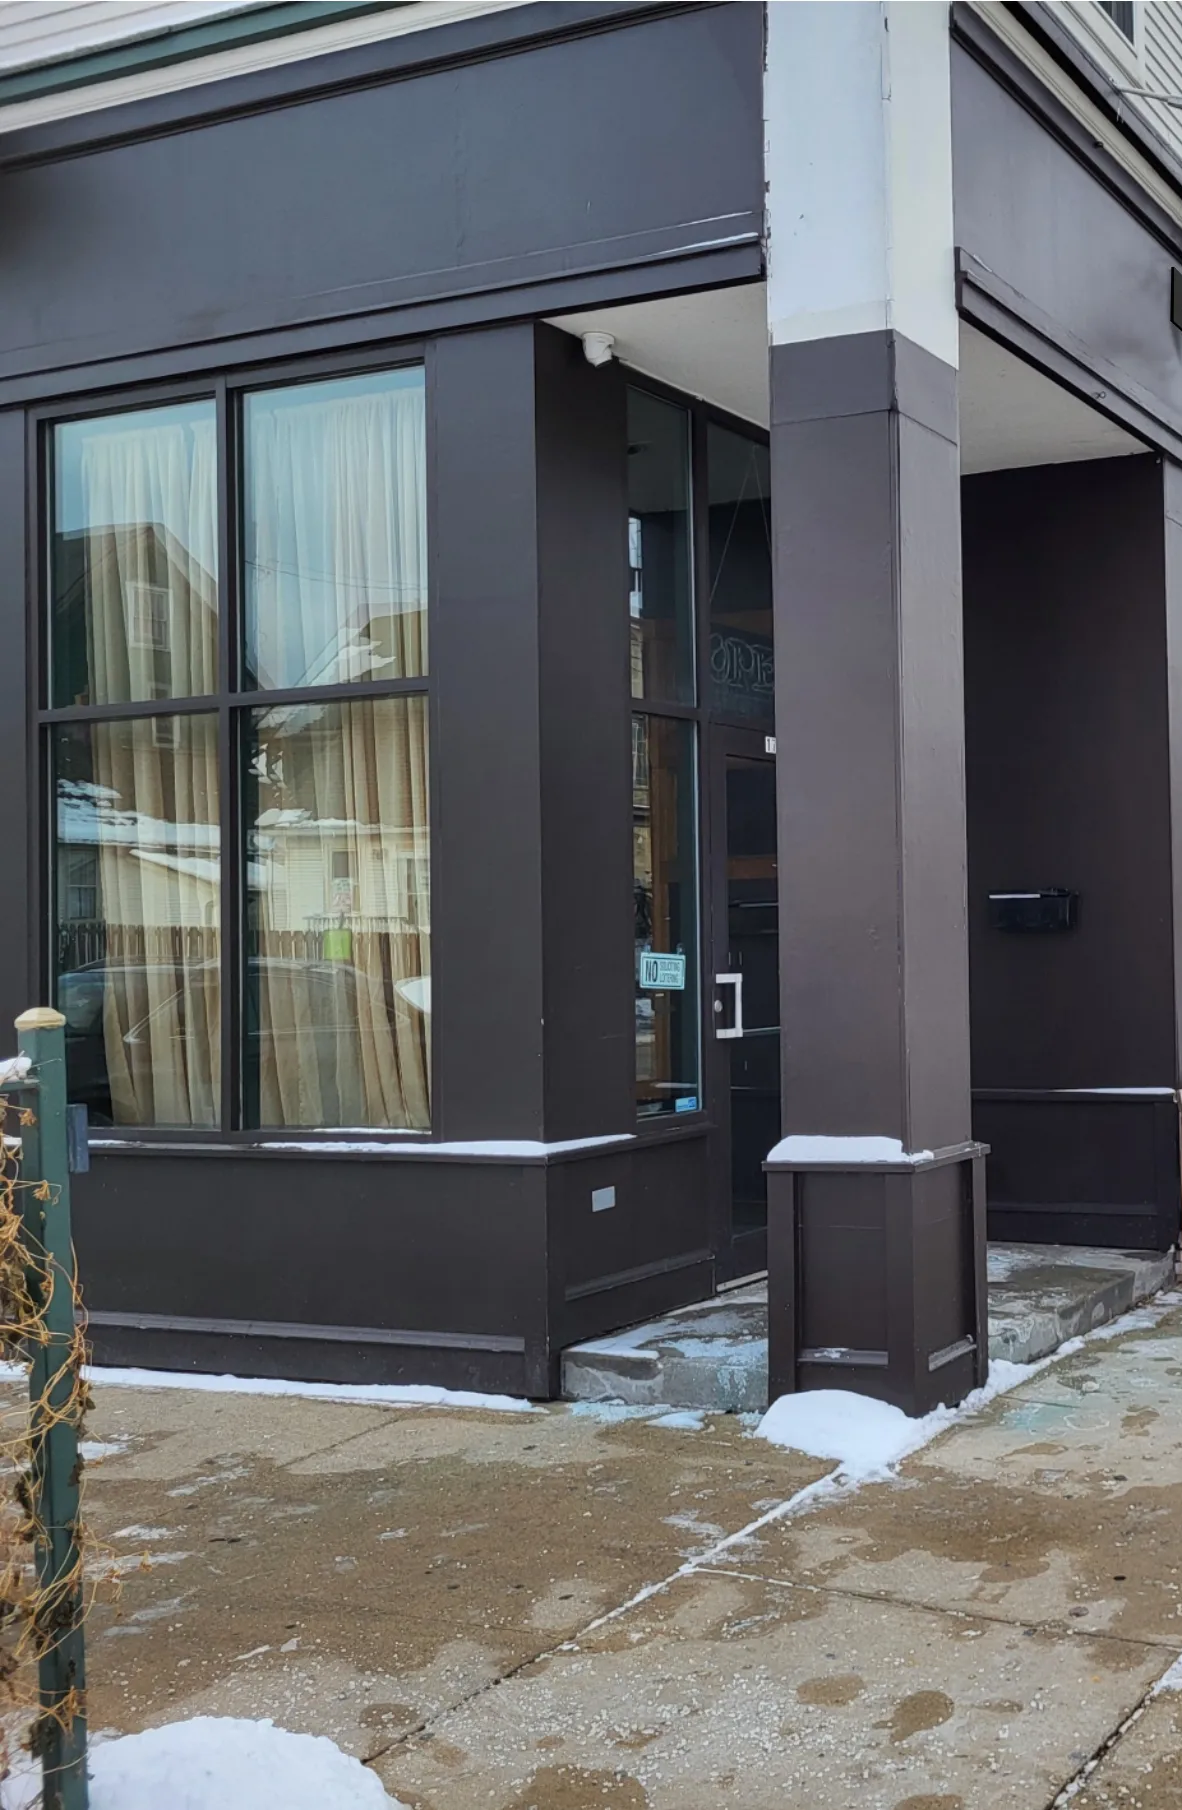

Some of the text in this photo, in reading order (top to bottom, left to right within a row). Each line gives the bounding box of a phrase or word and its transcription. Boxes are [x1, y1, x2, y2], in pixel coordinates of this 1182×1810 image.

[710, 633, 773, 692] OPE
[646, 960, 658, 983] NO
[660, 961, 681, 972] SOLICITING
[660, 972, 679, 984] LOITERING
